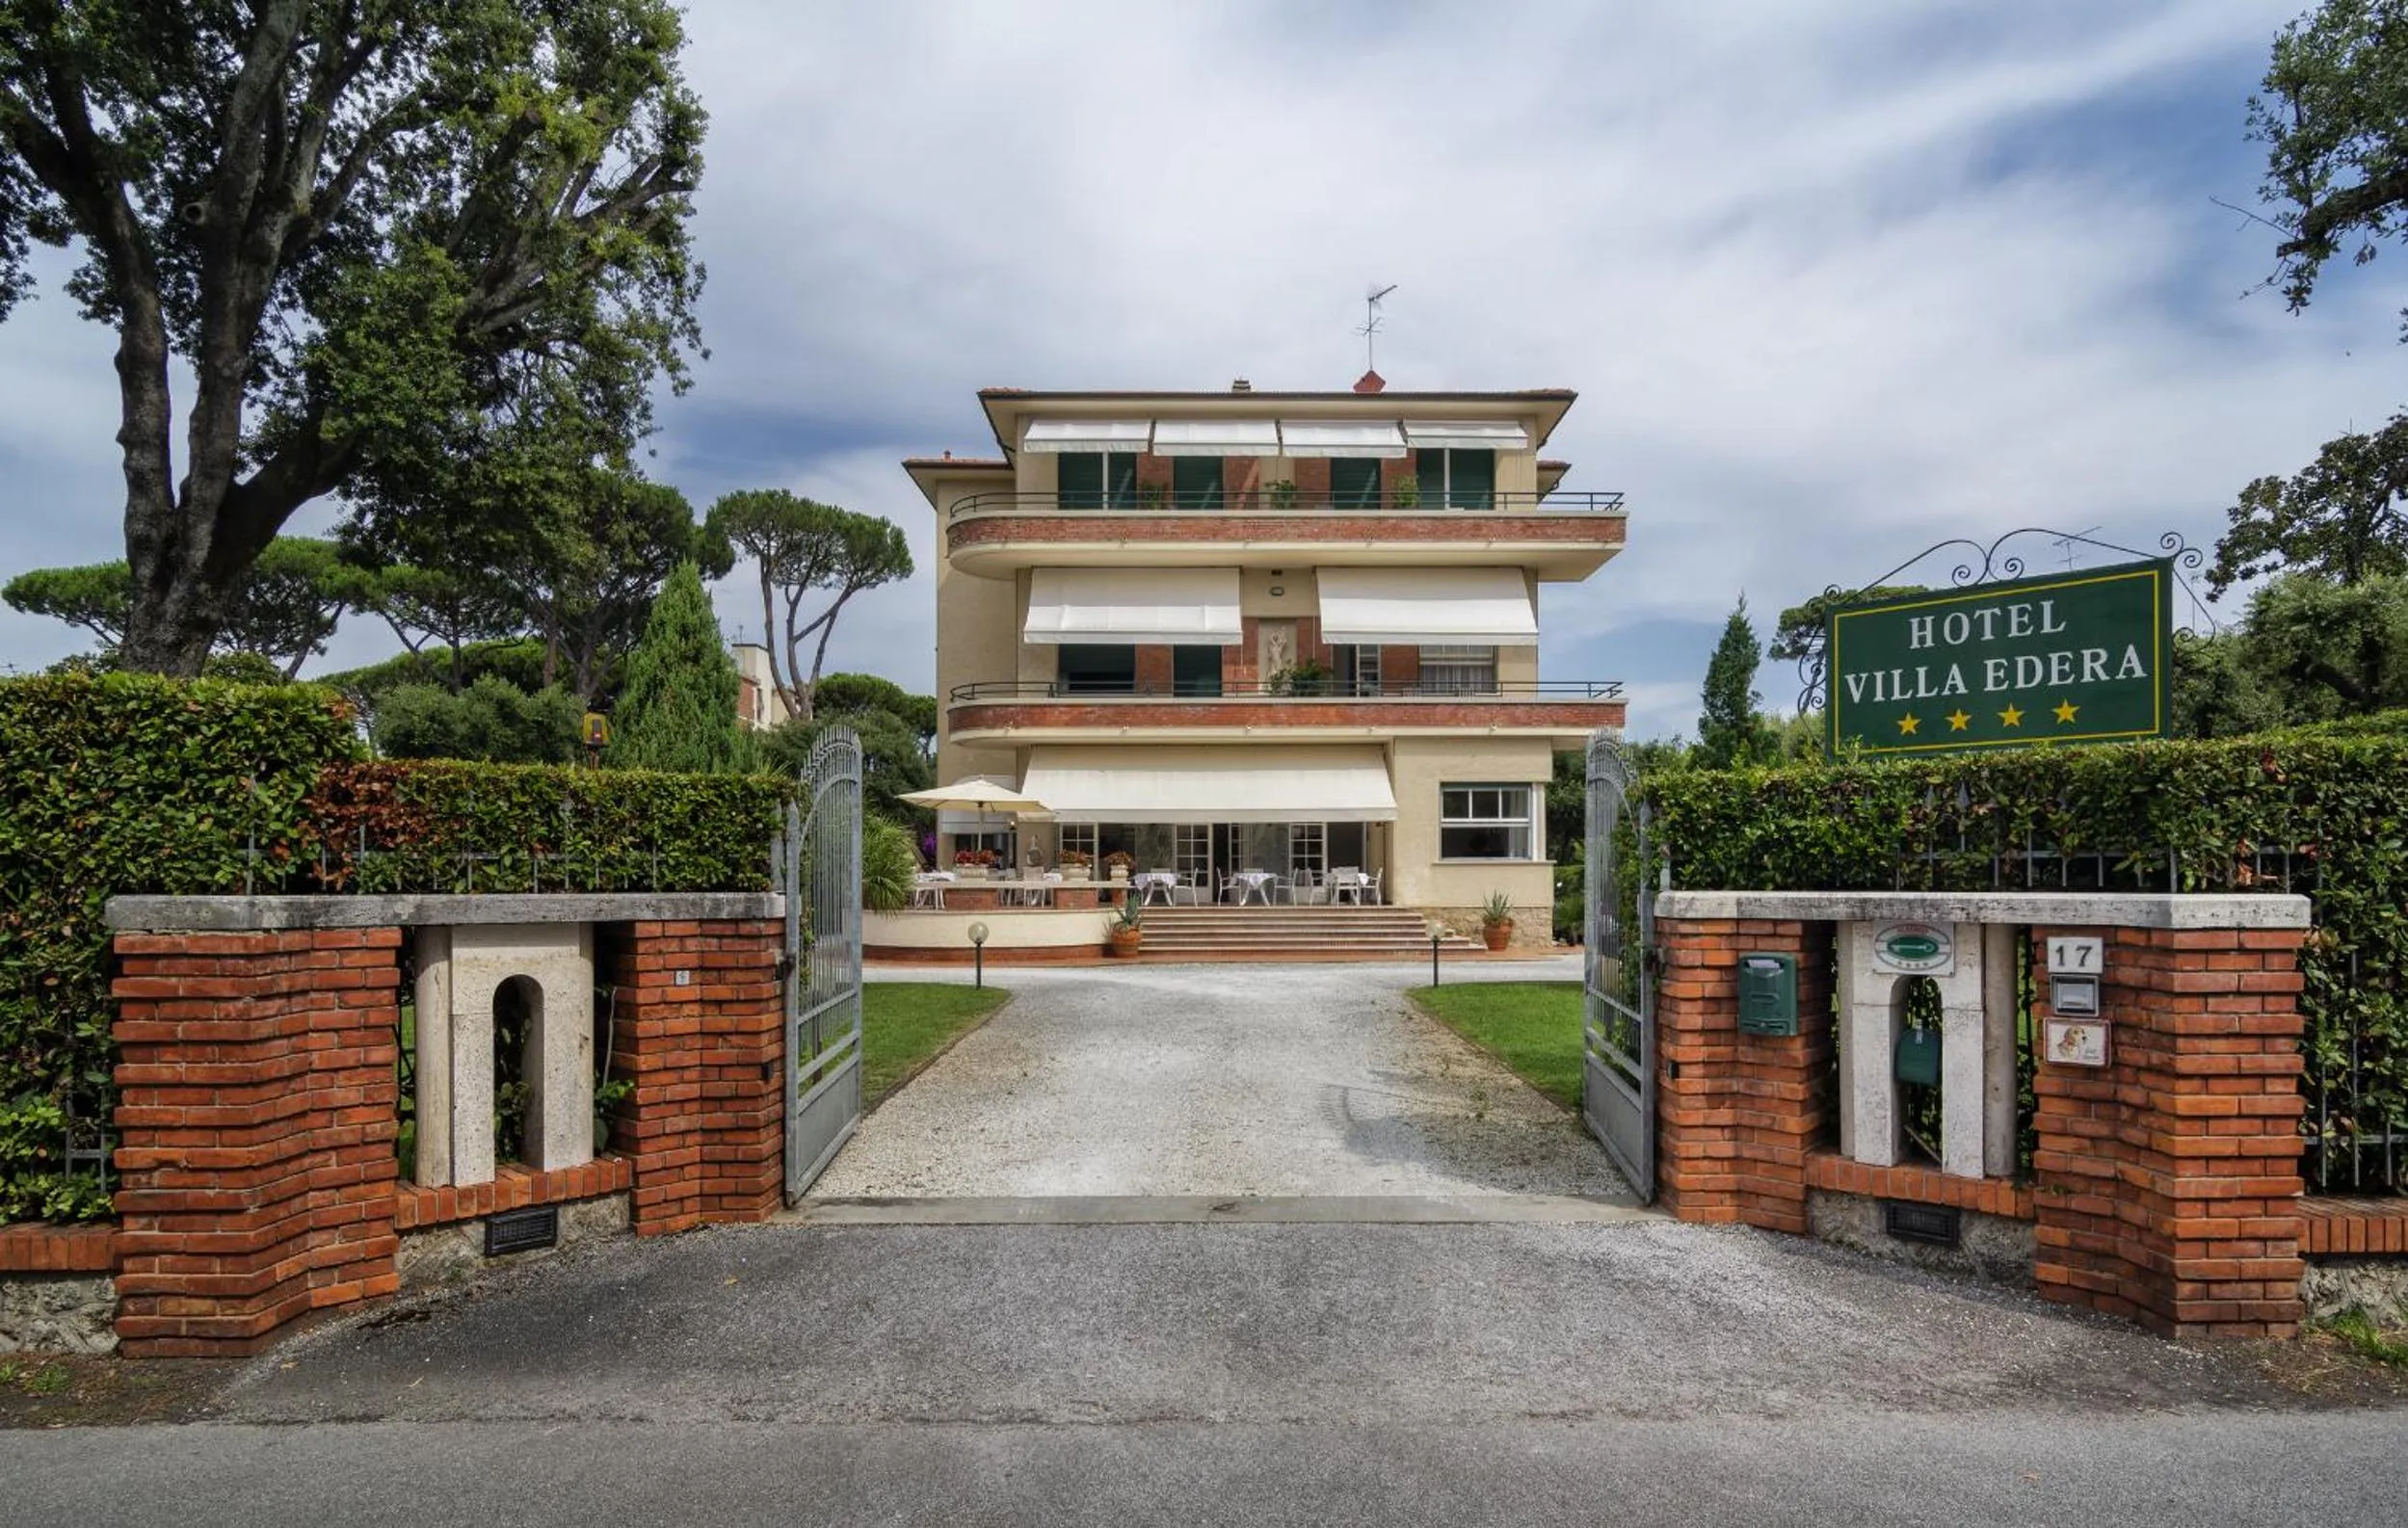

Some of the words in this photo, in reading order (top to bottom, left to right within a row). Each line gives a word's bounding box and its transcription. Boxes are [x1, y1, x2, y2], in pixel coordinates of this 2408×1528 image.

[1909, 600, 2066, 648] HOTEL
[1845, 664, 1968, 703] VILLA
[1983, 645, 2148, 692] EDERA
[2054, 944, 2093, 968] 17
